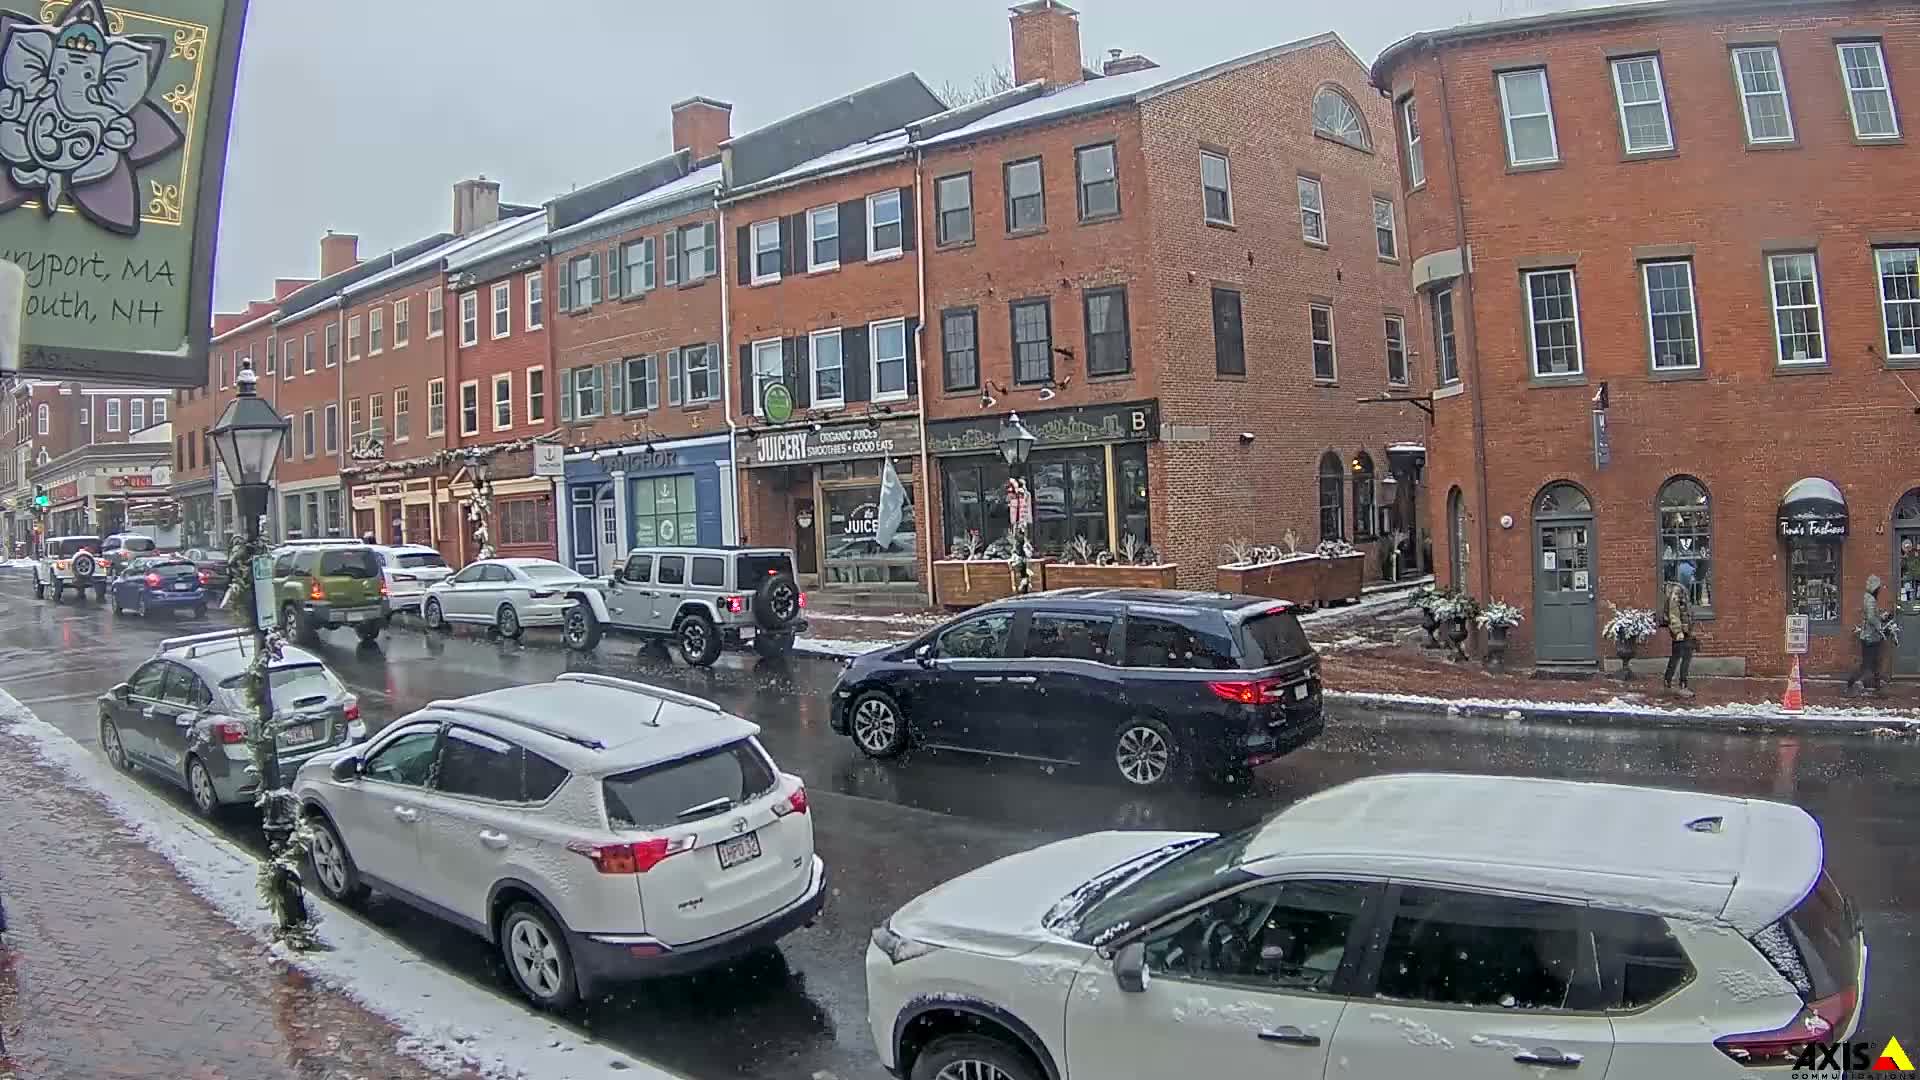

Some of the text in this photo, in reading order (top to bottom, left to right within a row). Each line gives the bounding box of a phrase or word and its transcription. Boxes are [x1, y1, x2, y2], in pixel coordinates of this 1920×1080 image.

[121, 257, 175, 287] MA
[25, 290, 164, 329] outh, NH
[1132, 411, 1146, 431] B
[820, 430, 851, 443] ORGANIC
[757, 432, 808, 462] JUICERY
[807, 439, 894, 457] SMOOTHIES GOOD EATS
[844, 519, 880, 534] JUICE
[1780, 520, 1845, 536] Tina's Fashions
